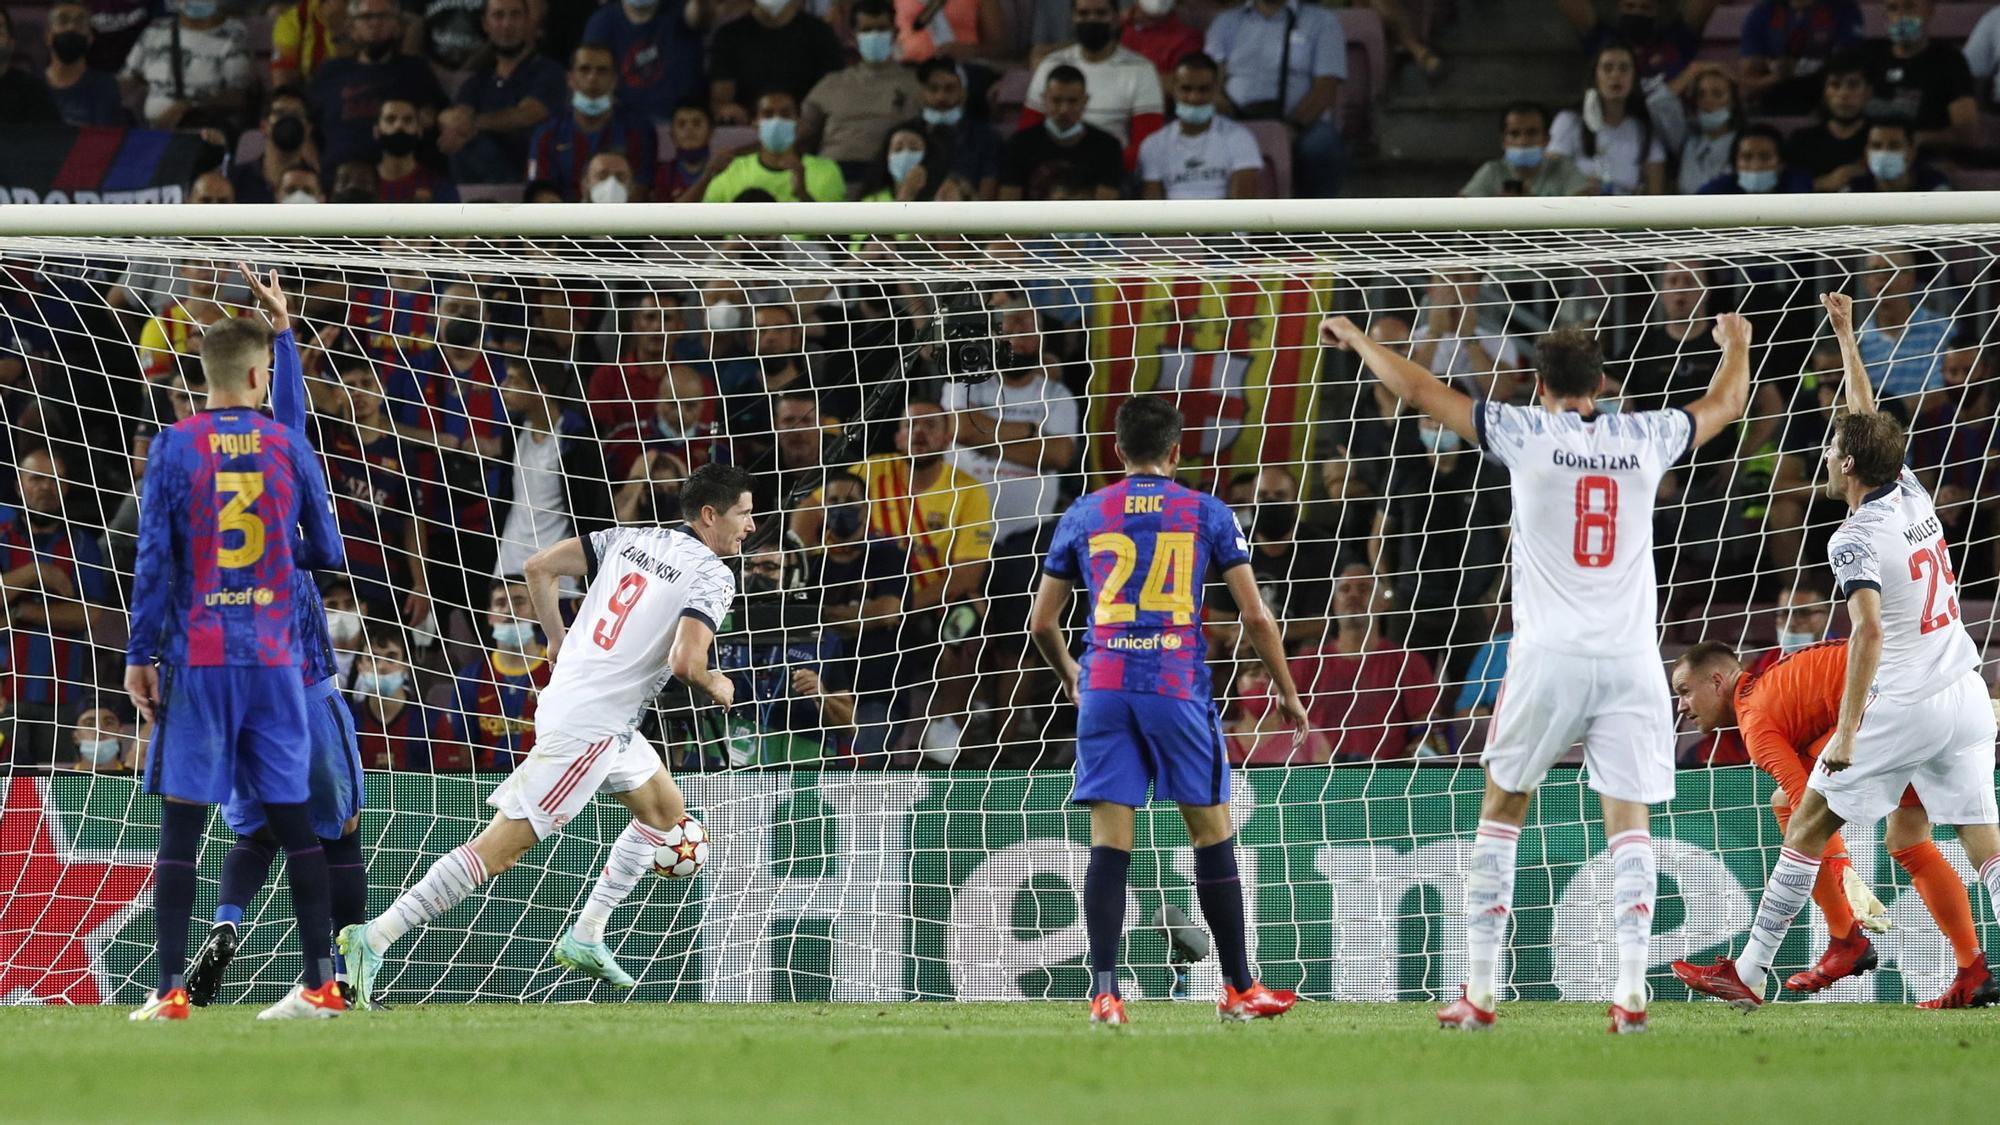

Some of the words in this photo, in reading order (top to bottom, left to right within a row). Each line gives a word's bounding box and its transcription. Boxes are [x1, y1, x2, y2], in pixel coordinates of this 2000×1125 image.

[208, 430, 262, 459] PIQUÉ
[1552, 449, 1640, 470] GORETZKA
[1124, 495, 1164, 514] ERIC
[215, 471, 266, 569] 3
[1573, 475, 1618, 568] 8
[1088, 531, 1196, 626] 24
[205, 588, 253, 606] unicef
[593, 572, 648, 651] 9
[1107, 633, 1162, 650] unicef
